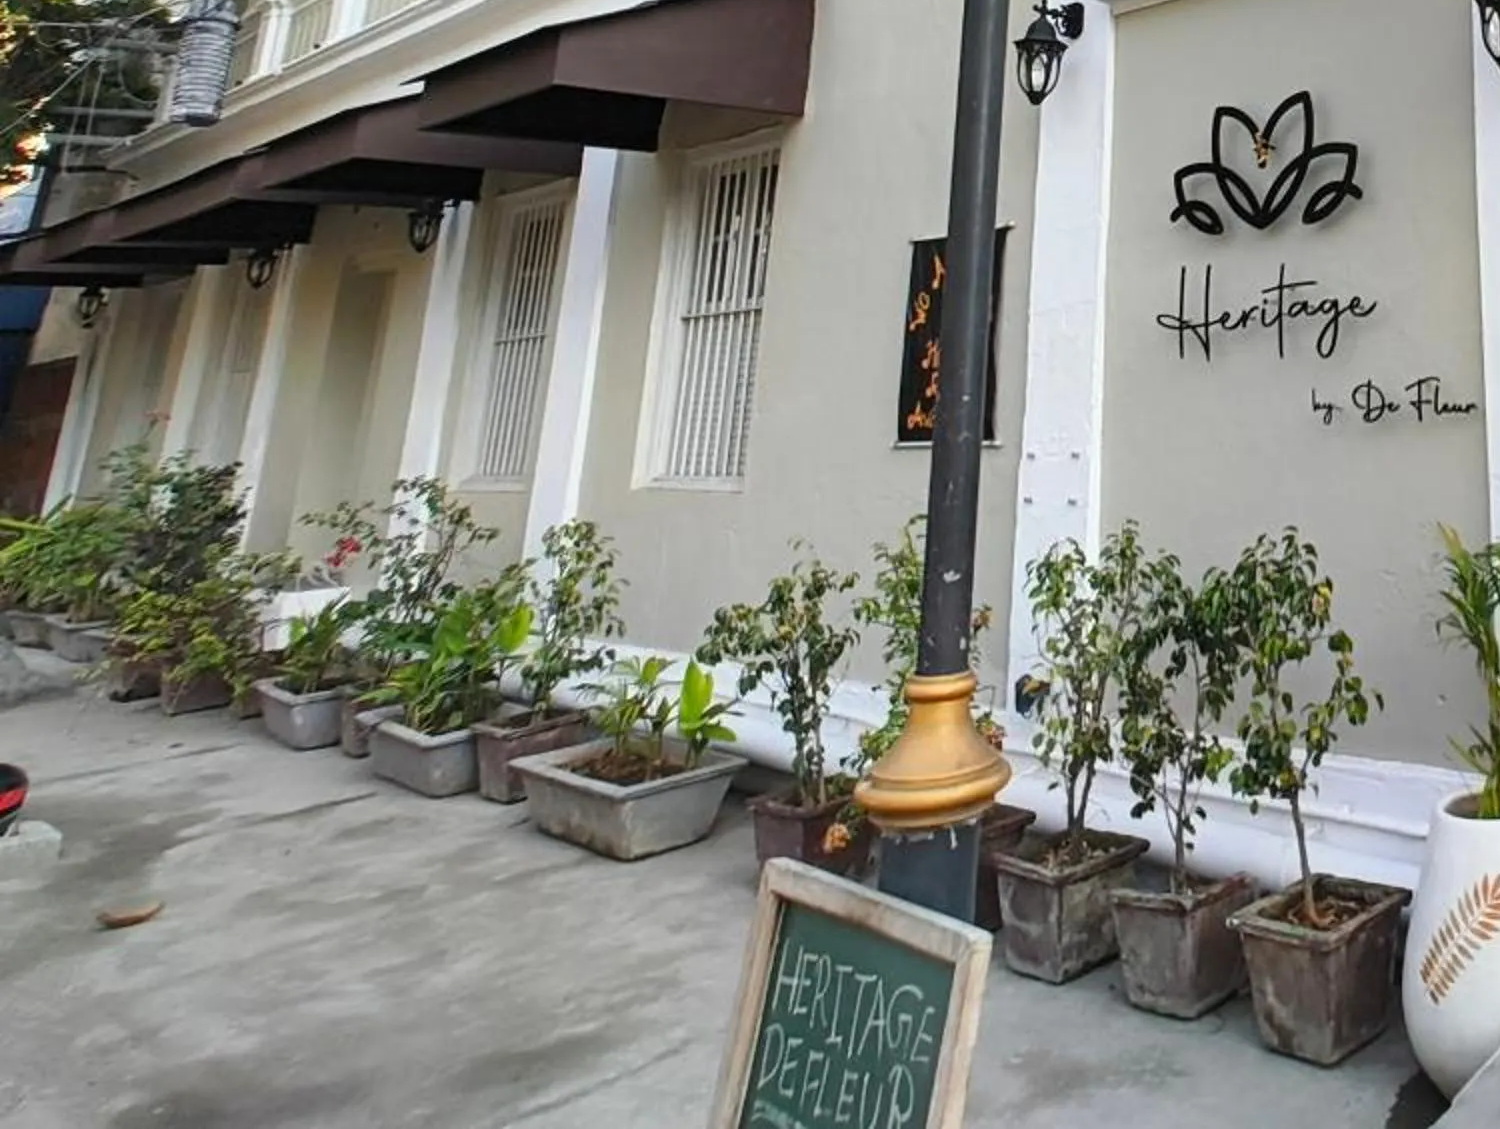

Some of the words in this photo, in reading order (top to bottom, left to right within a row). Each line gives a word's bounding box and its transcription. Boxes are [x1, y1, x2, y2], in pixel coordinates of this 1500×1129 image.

[1157, 263, 1377, 362] Heritage
[1311, 388, 1334, 425] by
[1352, 379, 1400, 423] De
[1405, 376, 1478, 422] Fleur
[771, 937, 936, 1064] HERITAGE
